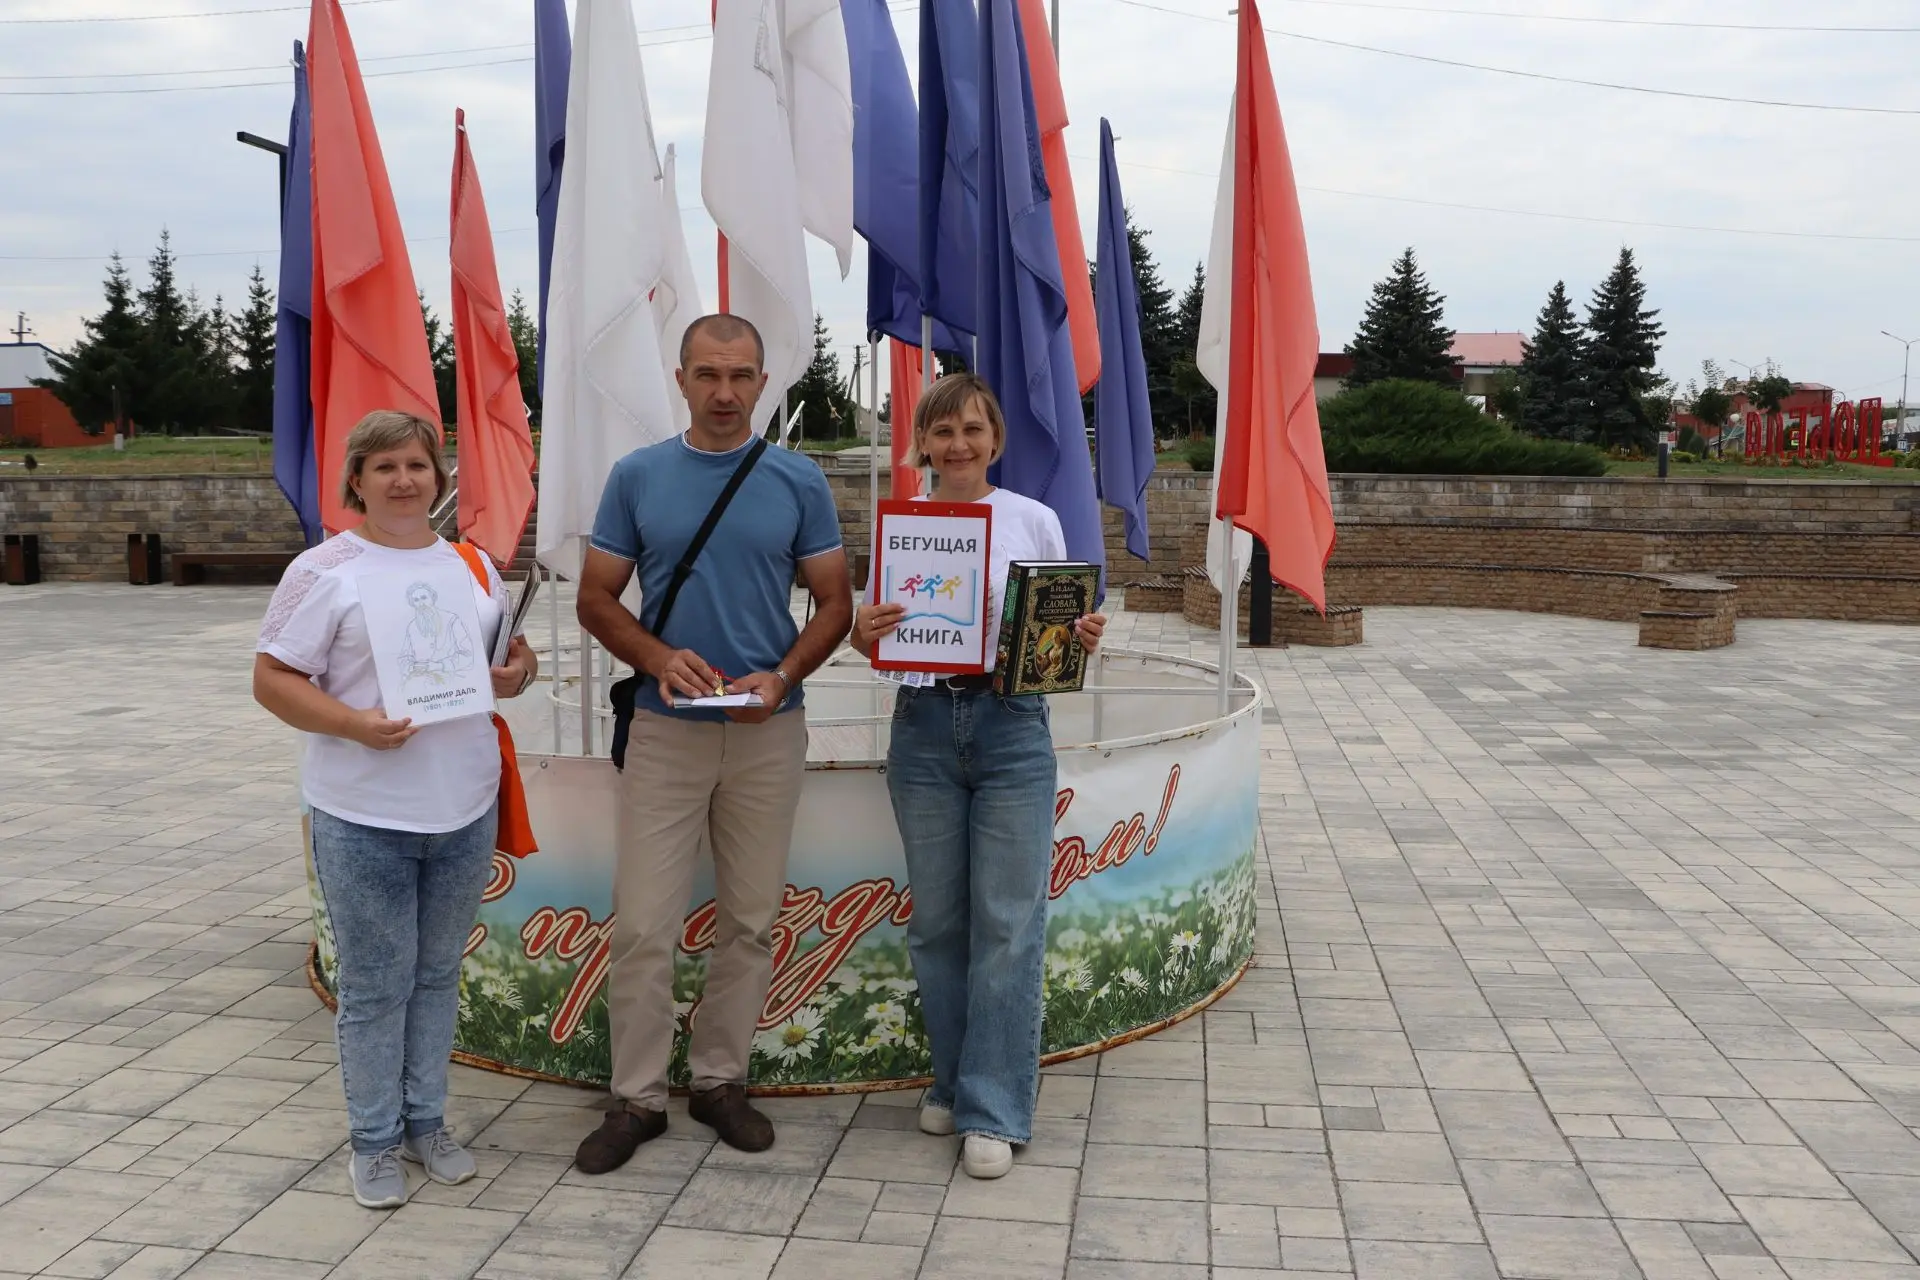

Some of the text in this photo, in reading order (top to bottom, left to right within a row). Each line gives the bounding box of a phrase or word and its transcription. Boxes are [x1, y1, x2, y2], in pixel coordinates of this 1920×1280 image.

[889, 536, 977, 554] БЕГУЩАЯ
[1043, 599, 1078, 609] СЛОВАРЬ
[896, 628, 964, 646] КНИГА
[407, 687, 477, 706] ВЛАДИМИР ДАЛЬ
